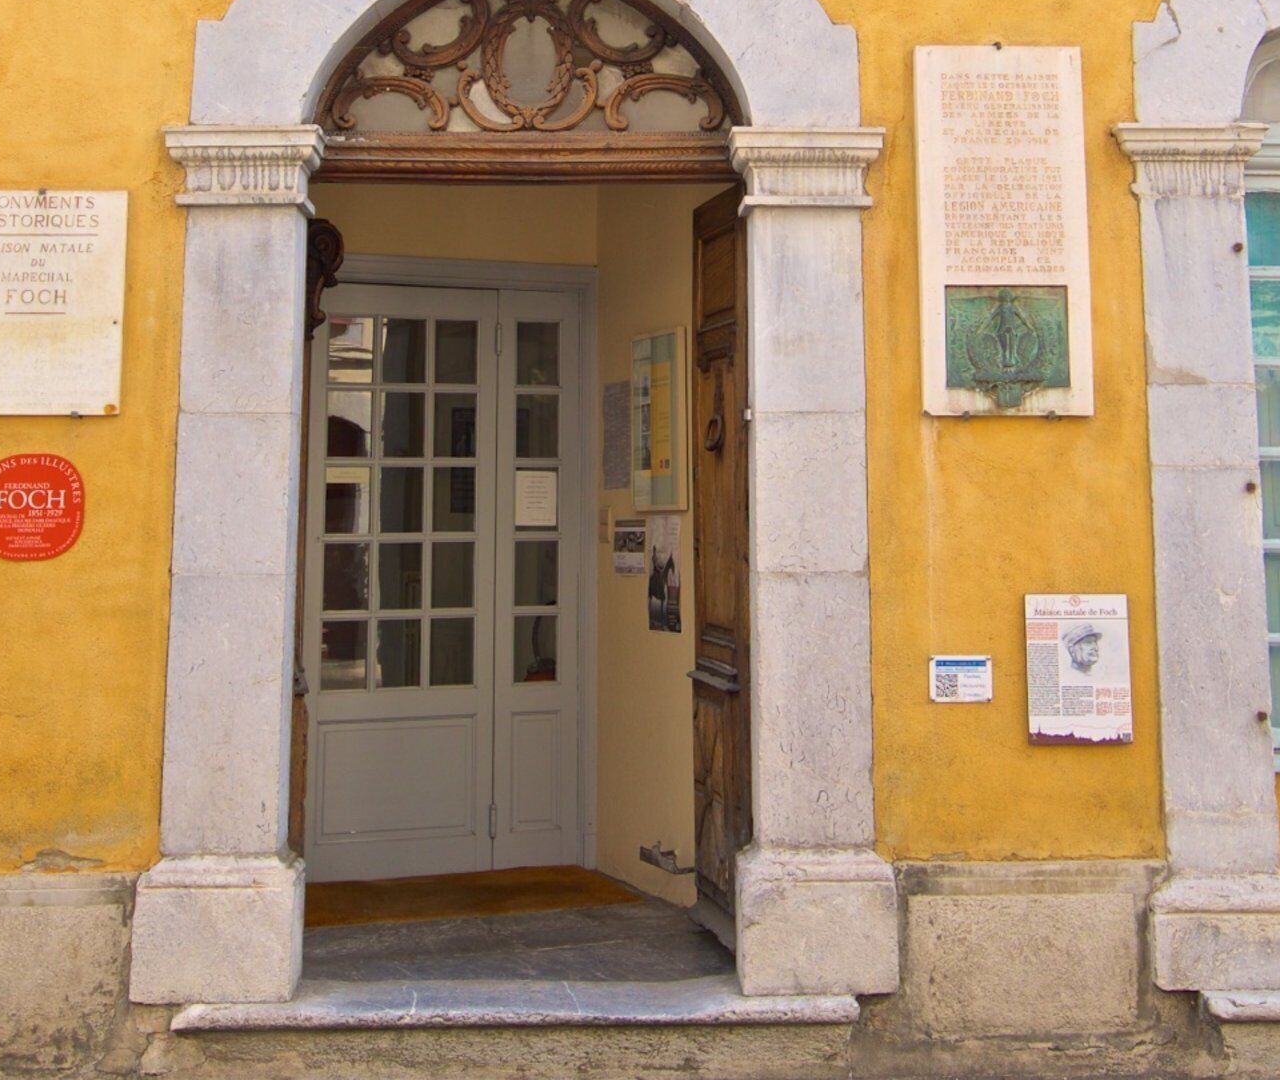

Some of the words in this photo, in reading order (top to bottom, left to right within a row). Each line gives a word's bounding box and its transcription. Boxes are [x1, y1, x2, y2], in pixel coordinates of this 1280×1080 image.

[39, 242, 94, 254] NATALE
[30, 258, 46, 267] DU
[4, 289, 67, 305] FOCH
[20, 457, 38, 466] DES
[40, 456, 81, 504] ILLUSTRES
